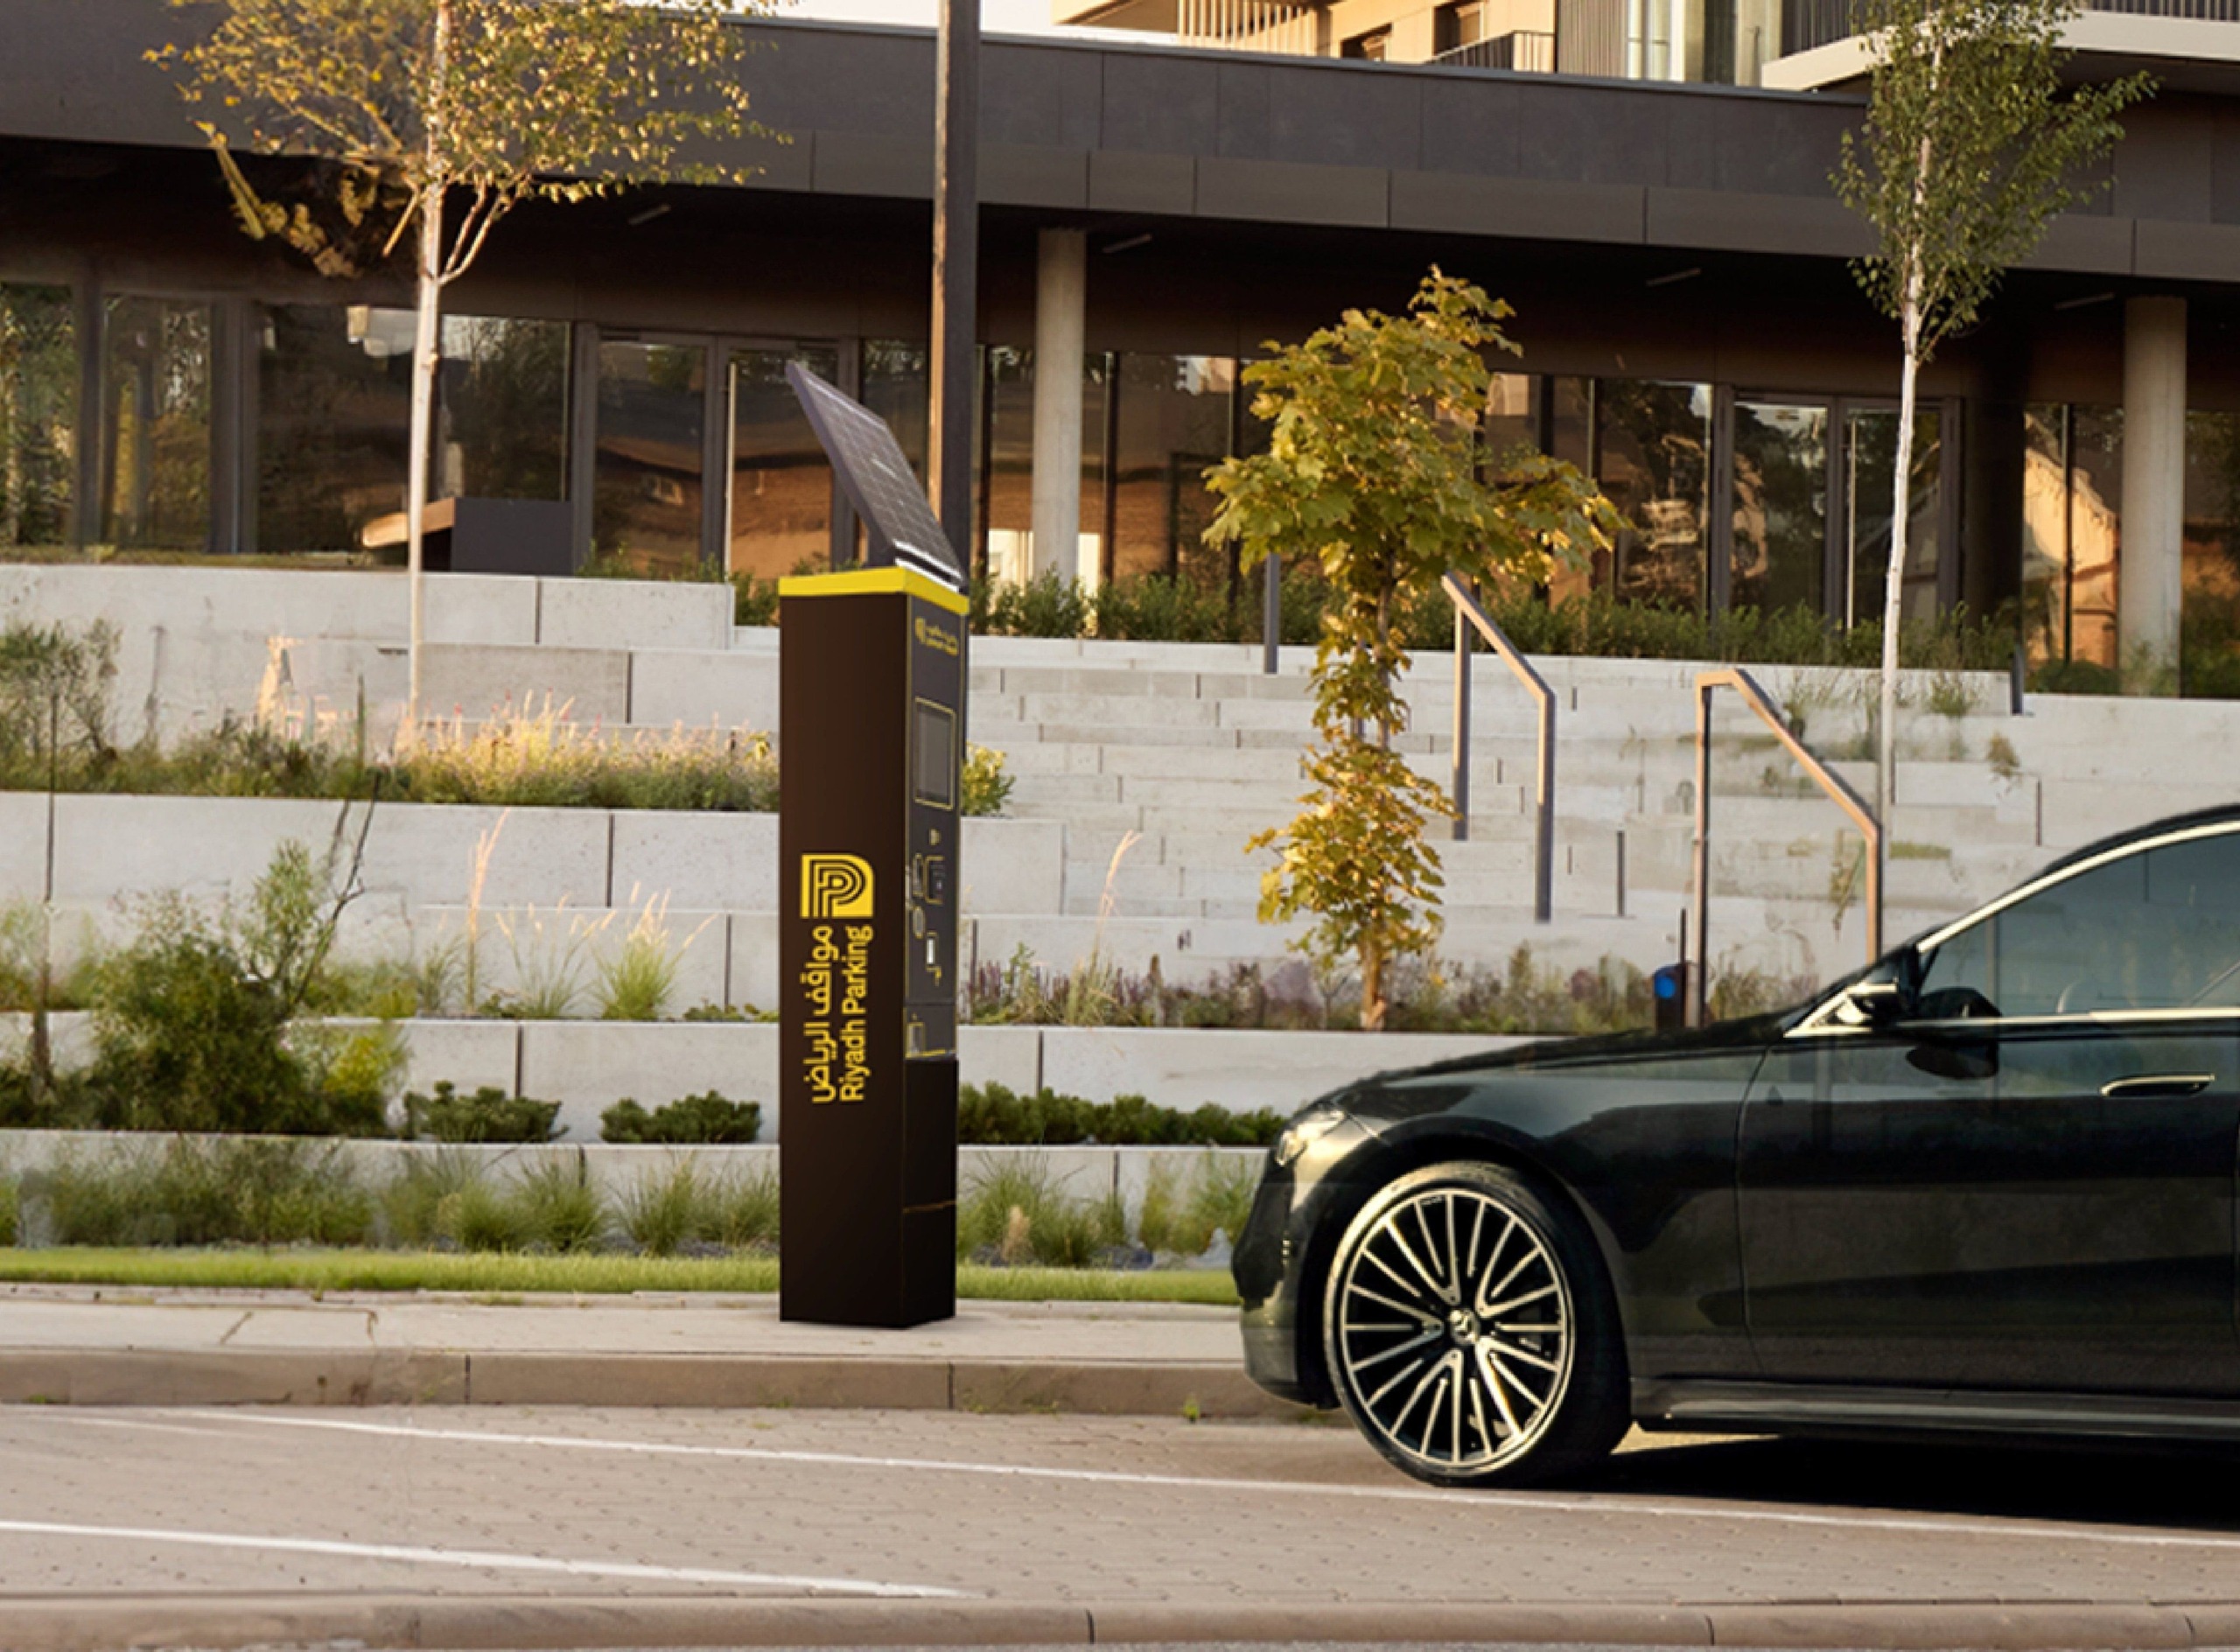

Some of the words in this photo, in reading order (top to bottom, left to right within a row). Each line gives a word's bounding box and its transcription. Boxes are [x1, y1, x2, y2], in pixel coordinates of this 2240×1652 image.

[801, 926, 839, 1016] مواقف
[841, 924, 874, 1015] Parking
[802, 1021, 837, 1102] الرياض
[837, 1019, 871, 1102] Riyadh
